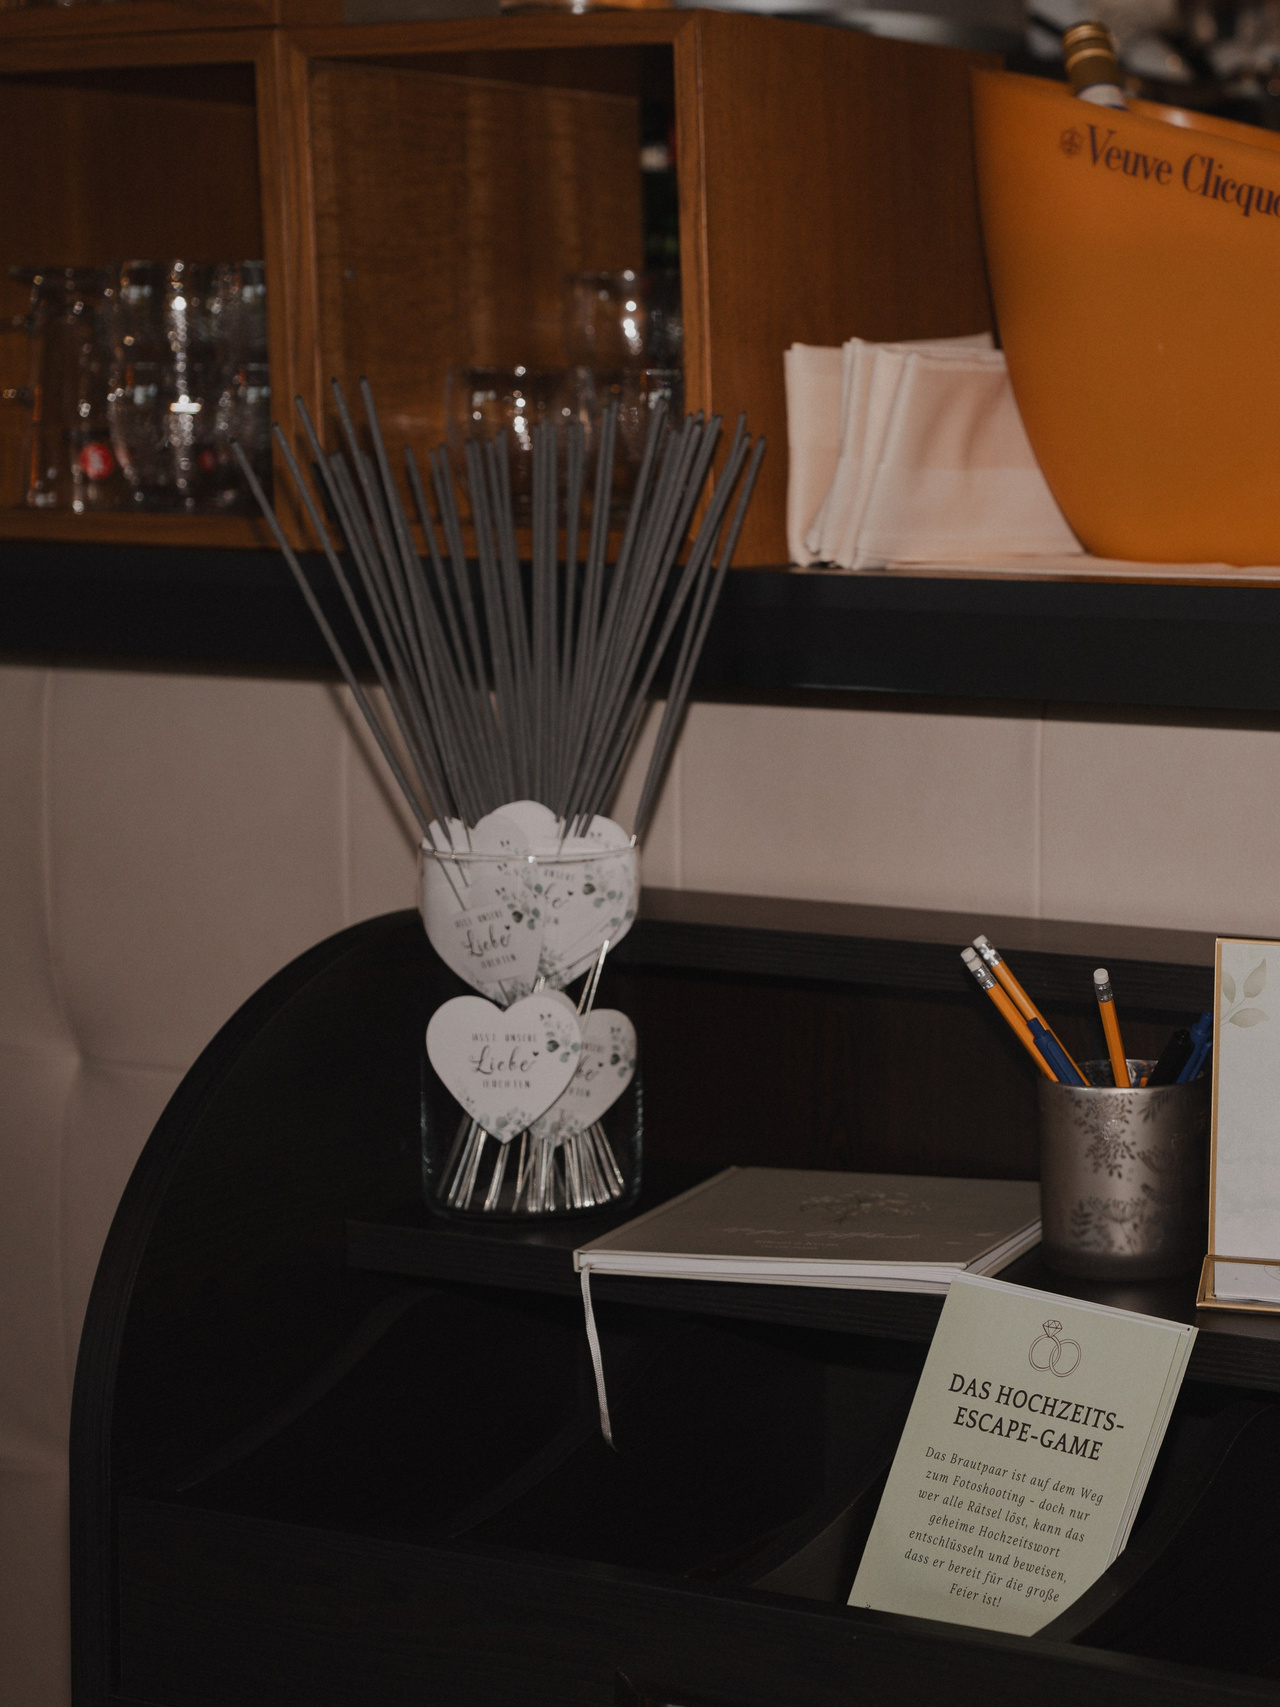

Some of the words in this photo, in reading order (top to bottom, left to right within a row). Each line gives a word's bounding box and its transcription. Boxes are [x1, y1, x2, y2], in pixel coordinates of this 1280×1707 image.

[1087, 124, 1173, 185] Veuve
[470, 1045, 536, 1075] Liebe
[948, 1373, 992, 1400] DAS
[994, 1384, 1124, 1431] HOCHZEITS-
[953, 1406, 1103, 1461] ESCAPE-GAME
[925, 1446, 946, 1461] Das
[950, 1453, 1008, 1477] Brautpaar
[1011, 1469, 1027, 1483] ist
[1030, 1477, 1051, 1492] auf
[1052, 1480, 1075, 1496] dem
[1081, 1487, 1103, 1506] Weg
[926, 1470, 948, 1483] zum
[952, 1475, 1025, 1507] Fotoshooting
[1039, 1498, 1065, 1515] doch
[1069, 1509, 1090, 1521] nur
[918, 1489, 940, 1501] wer
[942, 1495, 964, 1509] alle
[967, 1500, 1002, 1519] Rätsel
[1005, 1510, 1028, 1529] löst,
[1033, 1518, 1061, 1536] kann
[1065, 1528, 1085, 1542] das
[928, 1515, 975, 1534] geheime
[978, 1525, 1061, 1558] Hochzeitswort
[904, 1548, 929, 1564] dass
[932, 1559, 945, 1568] er
[948, 1560, 982, 1579] bereit
[983, 1571, 1003, 1585] für
[1006, 1577, 1023, 1591] die
[1025, 1586, 1059, 1603] große
[909, 1530, 984, 1558] entschlüsseln
[988, 1552, 1011, 1565] und
[1013, 1556, 1066, 1584] beweisen,
[949, 1583, 979, 1600] Feier
[982, 1592, 1002, 1607] ist!
